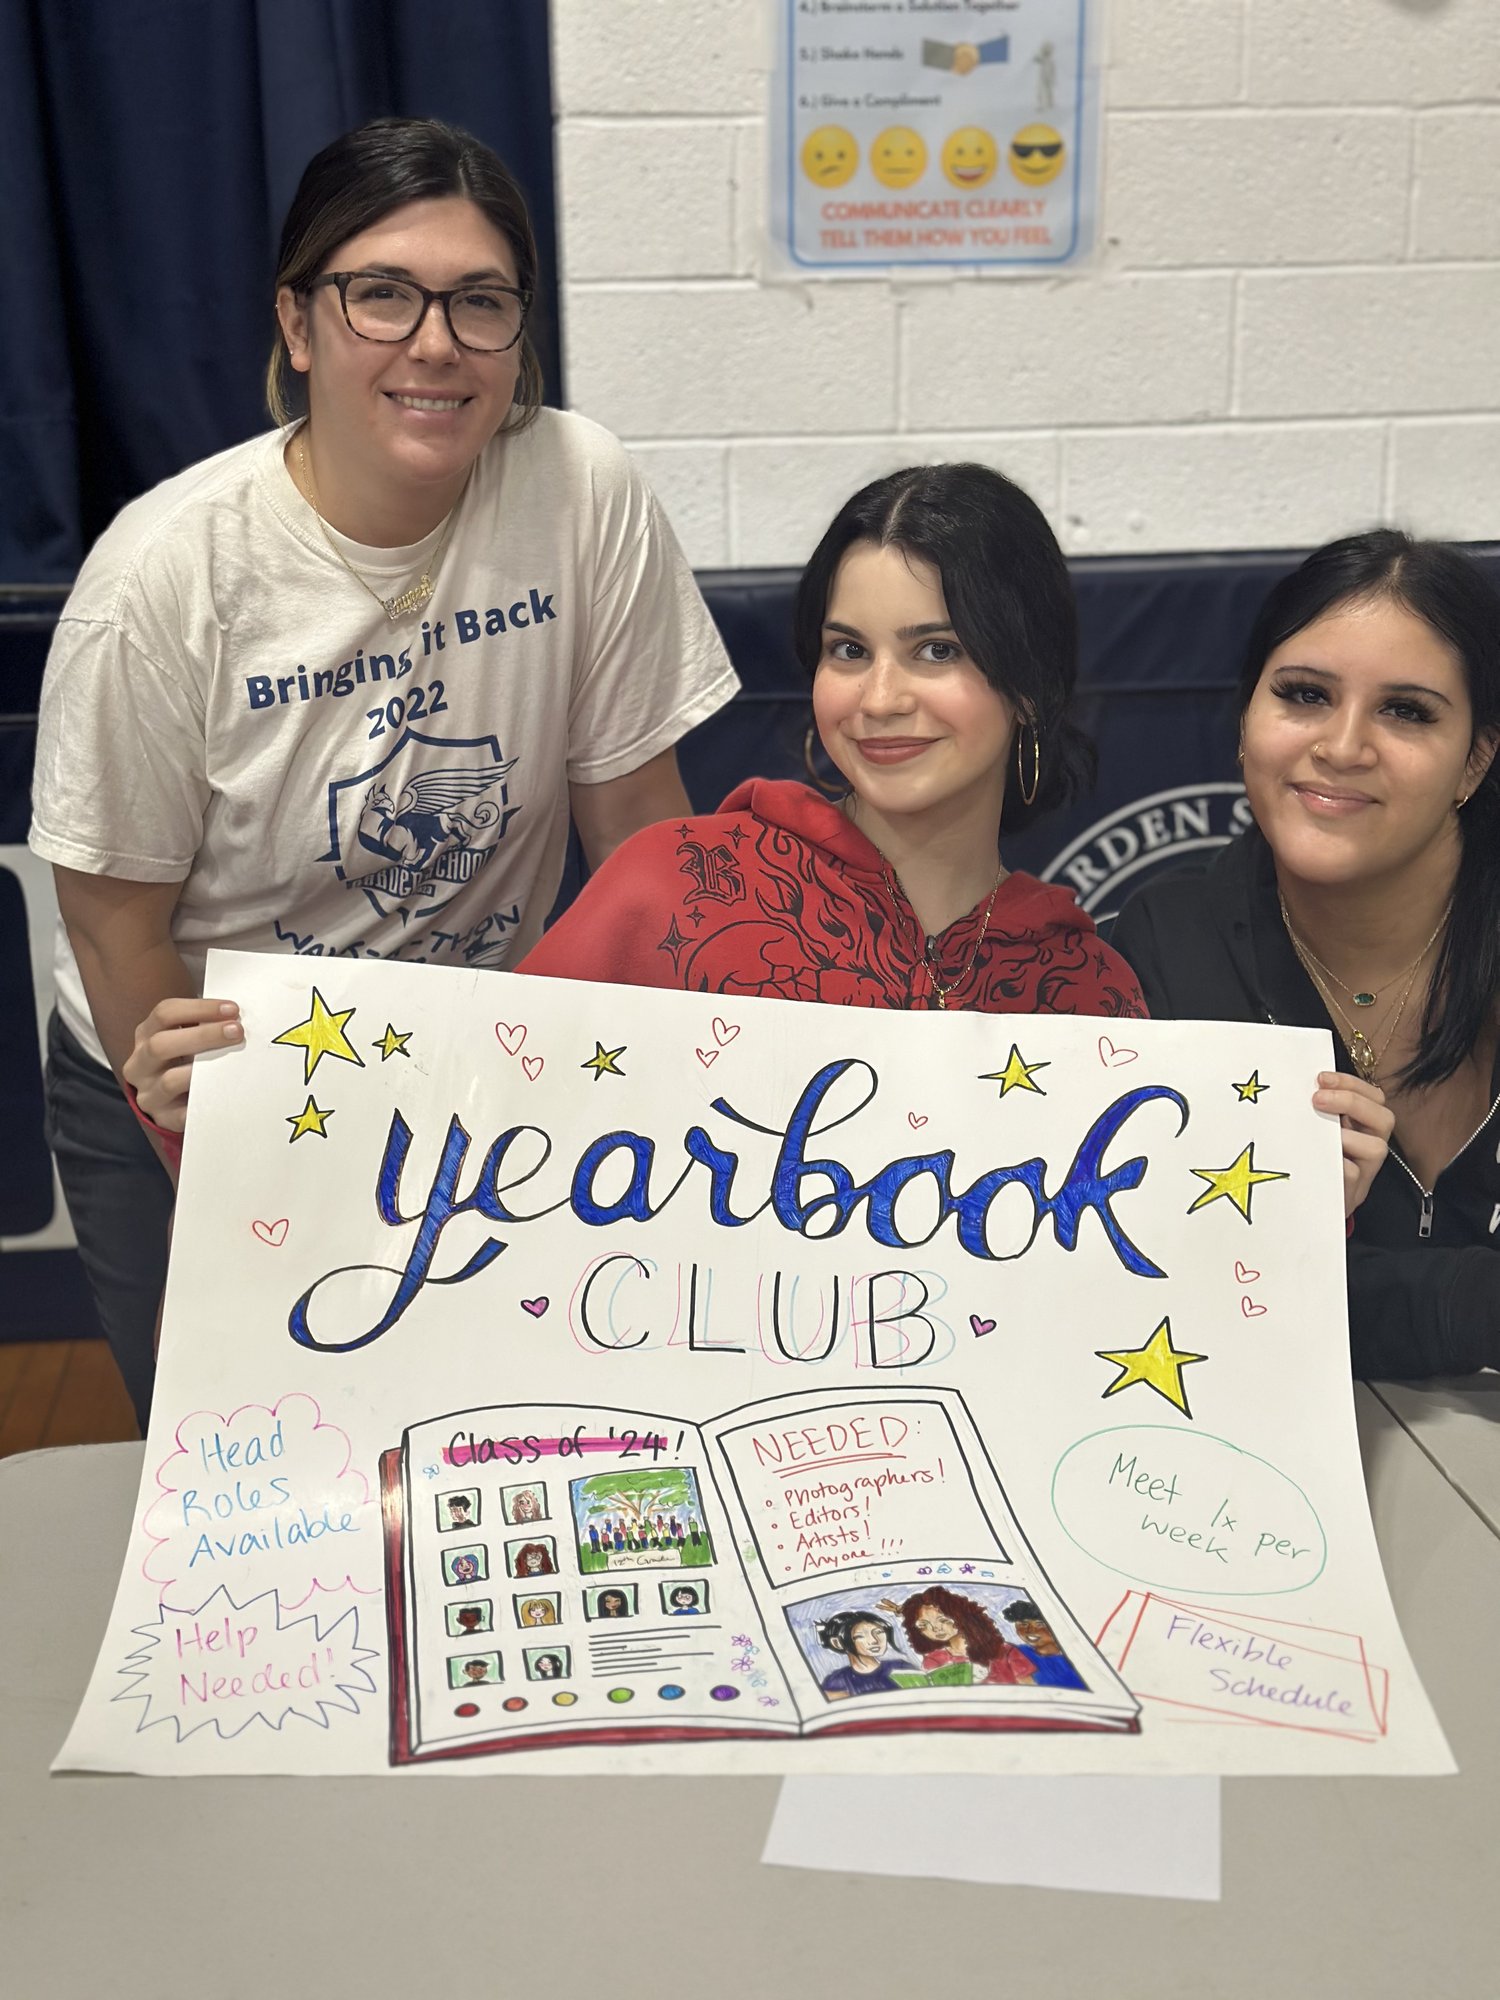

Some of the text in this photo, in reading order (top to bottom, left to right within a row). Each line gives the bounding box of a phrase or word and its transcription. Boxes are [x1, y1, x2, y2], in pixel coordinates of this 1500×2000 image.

[864, 93, 942, 109] Compliment
[820, 198, 1047, 221] COMMUNICATE CLEARLY
[819, 225, 1053, 249] TELL THEM HOW YOU FEEL
[421, 621, 447, 656] it
[454, 588, 557, 645] Back
[366, 679, 448, 741] 2022
[288, 1058, 1191, 1354] yearbook
[572, 1252, 948, 1371] CLUB
[201, 1420, 287, 1474] Head
[448, 1431, 541, 1468] Class
[558, 1425, 587, 1459] of
[182, 1477, 291, 1527] Roles
[1107, 1452, 1183, 1505] Meet
[1254, 1532, 1312, 1560] per
[188, 1508, 362, 1568] Available
[1141, 1513, 1229, 1564] week
[175, 1617, 259, 1660] Help
[1165, 1614, 1293, 1671] Flexible
[1208, 1668, 1358, 1718] Schedule
